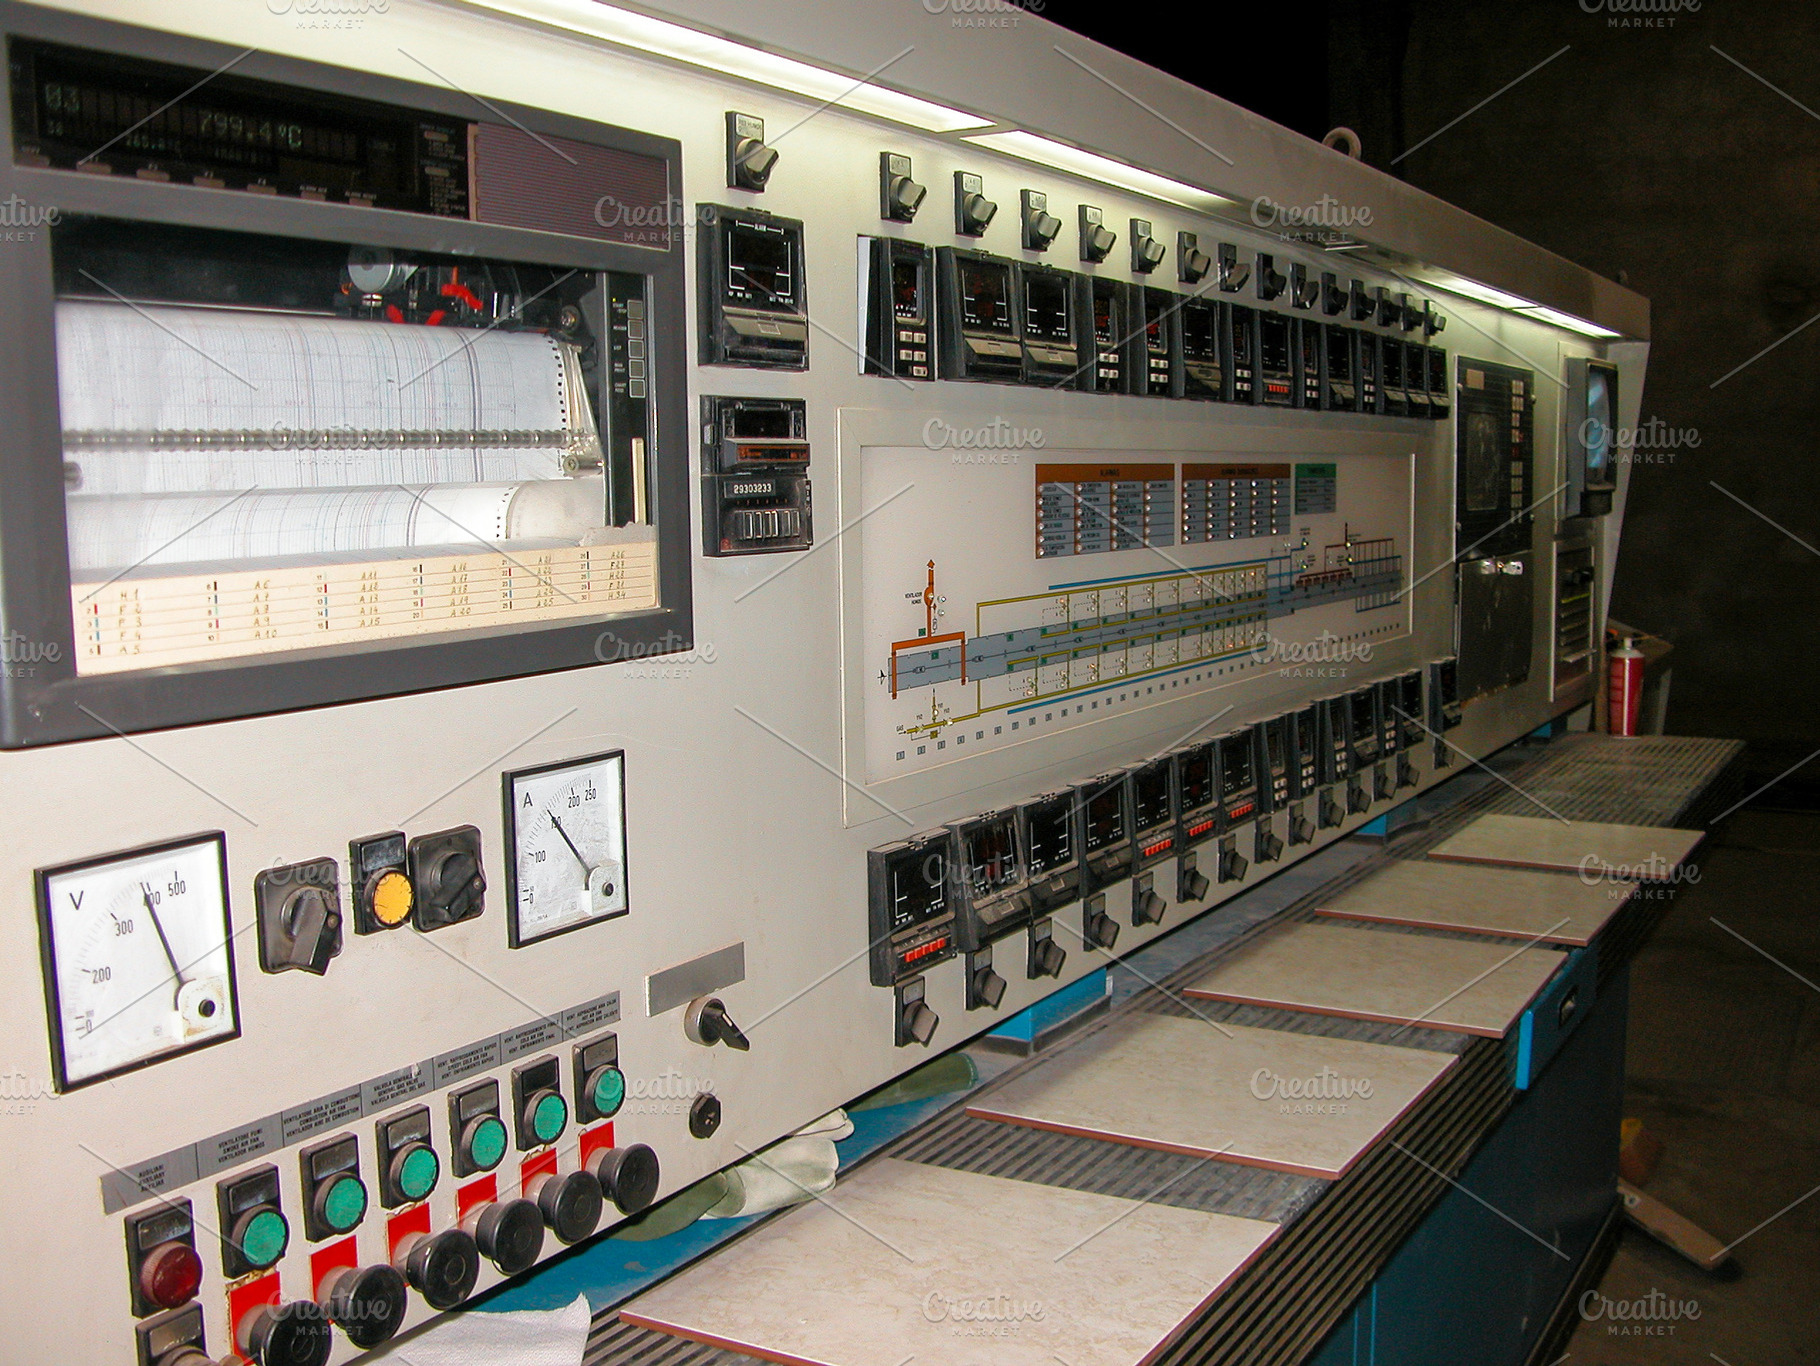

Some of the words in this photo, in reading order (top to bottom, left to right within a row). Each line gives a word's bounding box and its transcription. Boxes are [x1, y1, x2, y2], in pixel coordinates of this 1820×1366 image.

[523, 792, 533, 808] A
[568, 795, 580, 808] 200
[584, 788, 597, 801] 250
[535, 850, 546, 863] 100
[168, 880, 186, 897] 500
[69, 890, 84, 910] V
[529, 892, 534, 904] 0
[115, 919, 134, 936] 300
[92, 966, 111, 984] 200
[86, 1019, 93, 1033] 0
[249, 1136, 258, 1144] FAN
